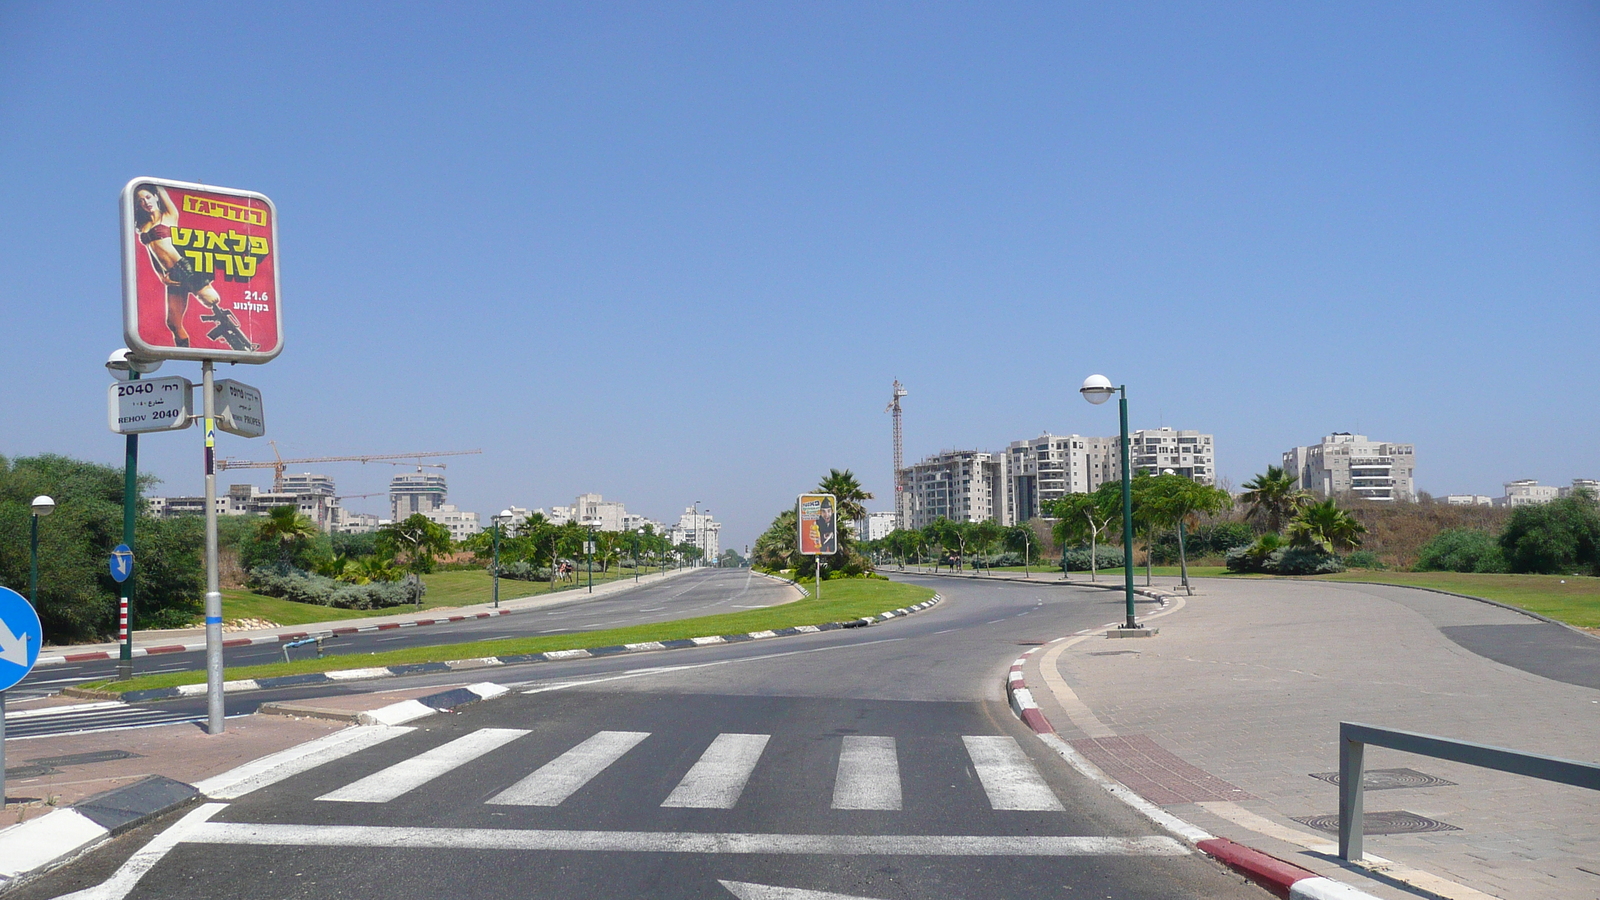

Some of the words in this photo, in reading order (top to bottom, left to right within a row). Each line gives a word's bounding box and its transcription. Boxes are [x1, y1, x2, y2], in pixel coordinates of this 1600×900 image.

[188, 197, 263, 224] רודריגז
[170, 226, 270, 255] פלאנט
[185, 249, 257, 277] טרור
[233, 301, 269, 313] בקולנוע
[118, 383, 153, 397] 2040
[118, 415, 147, 424] REHOV
[152, 408, 179, 420] 2040
